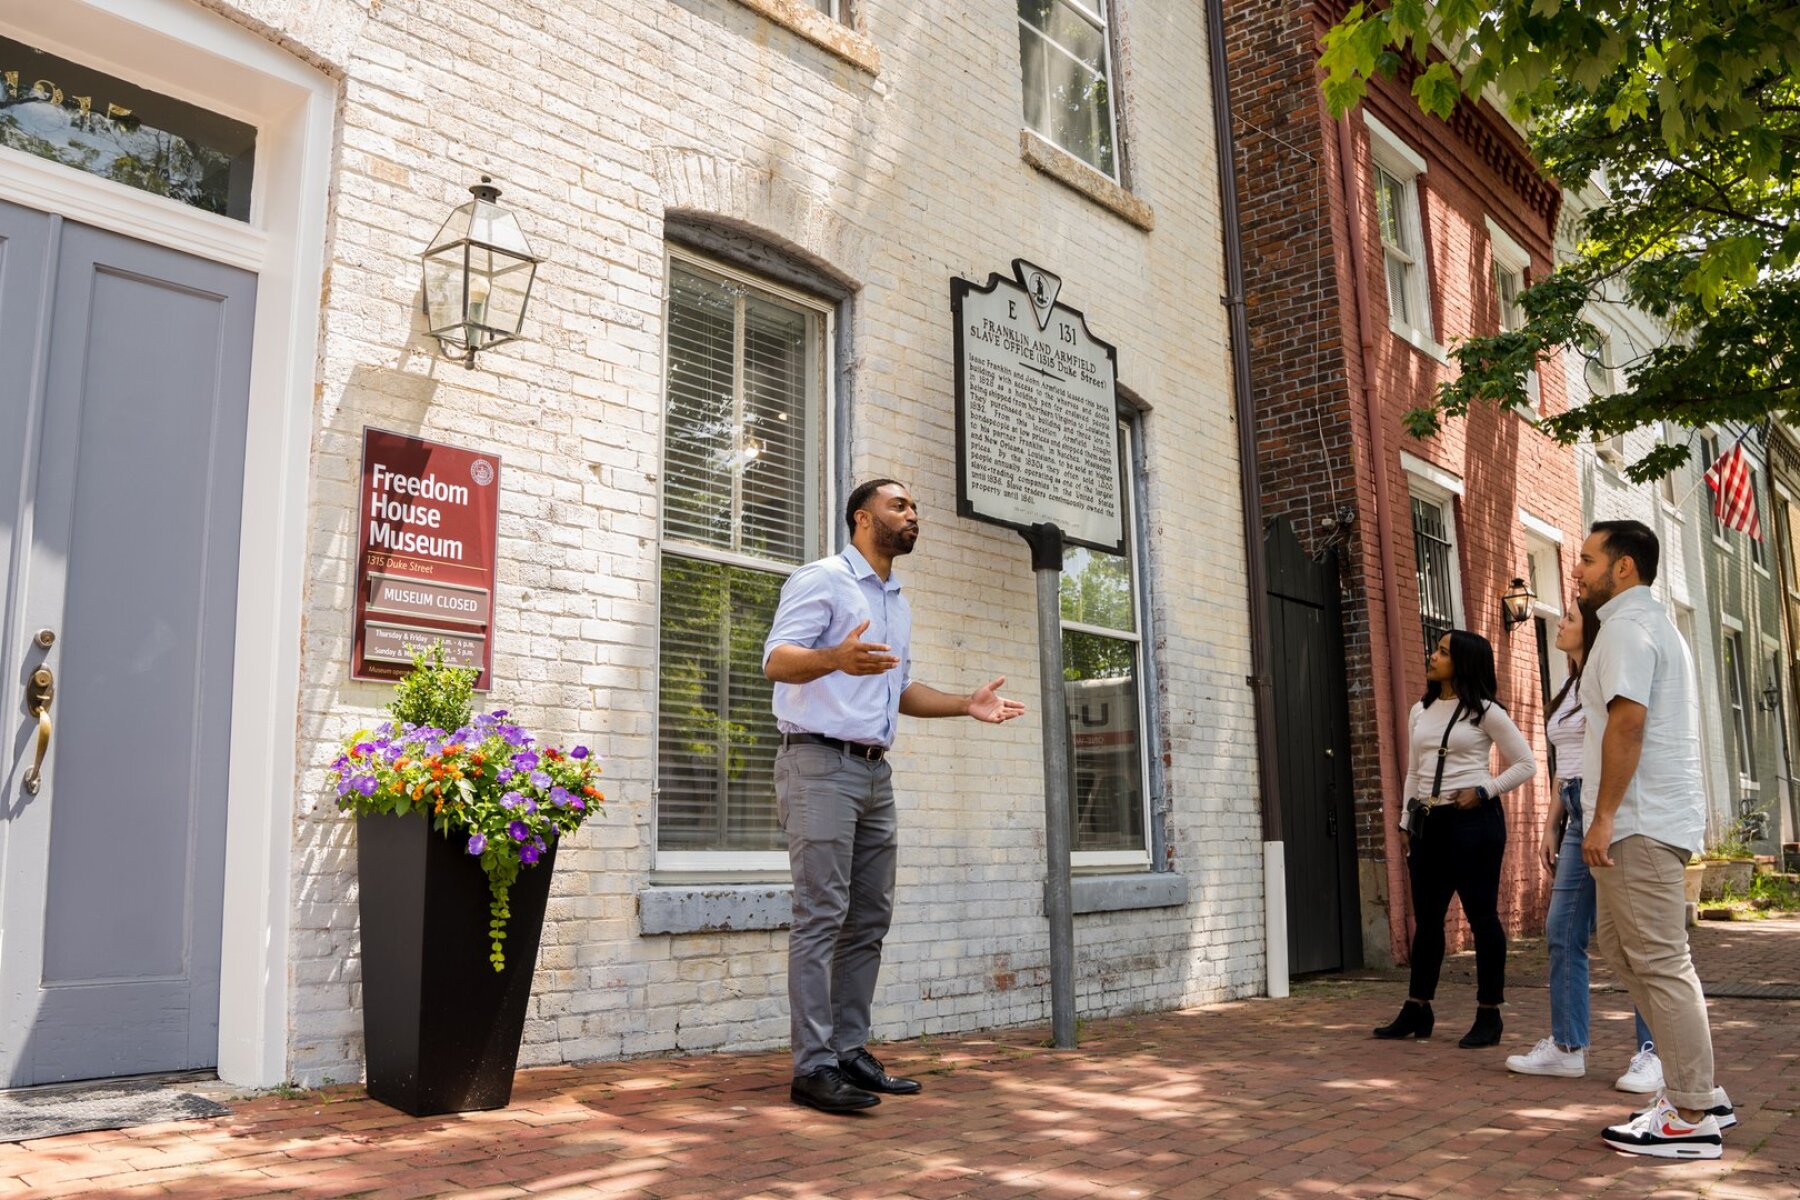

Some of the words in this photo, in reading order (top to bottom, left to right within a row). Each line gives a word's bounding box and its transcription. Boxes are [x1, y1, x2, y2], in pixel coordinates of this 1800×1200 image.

[1008, 300, 1017, 320] E
[1059, 322, 1077, 346] 131
[970, 324, 1000, 347] SLAVE
[1003, 338, 1034, 360] OFFICE
[1036, 352, 1054, 369] (1315
[1057, 360, 1077, 378] Duke
[1080, 370, 1106, 390] Street)
[983, 318, 1028, 347] FRANKLIN
[1033, 339, 1050, 356] AND
[1055, 348, 1095, 374] ARMFIELD
[969, 363, 995, 381] building
[998, 375, 1012, 385] with
[1014, 381, 1033, 393] access
[1036, 388, 1042, 396] to
[1044, 391, 1054, 400] the
[1093, 409, 1109, 421] docks
[969, 372, 975, 381] in
[1014, 389, 1039, 406] holding
[1040, 400, 1052, 409] pen
[1053, 403, 1062, 412] for
[1064, 409, 1090, 422] enslaved
[1092, 419, 1110, 430] people
[970, 382, 987, 397] being
[988, 390, 1011, 403] shipped
[1012, 397, 1026, 409] from
[1028, 403, 1053, 418] Northern
[1054, 412, 1076, 426] Virginia
[986, 360, 1011, 375] Franklin
[1013, 371, 1024, 380] and
[1025, 374, 1040, 386] John
[1041, 380, 1065, 396] Armfield
[1085, 397, 1094, 406] this
[1096, 401, 1108, 412] brick
[970, 392, 986, 406] They
[990, 401, 1022, 416] purchased
[1024, 411, 1035, 421] the
[1038, 416, 1061, 432] building
[1063, 426, 1074, 434] and
[1076, 429, 1091, 440] three
[970, 411, 1009, 431] bondspeople
[1019, 428, 1030, 437] low
[1032, 434, 1049, 444] prices
[1062, 443, 1083, 455] shipped
[1084, 449, 1098, 460] them
[1098, 456, 1111, 464] south
[970, 421, 977, 430] to
[980, 424, 989, 434] his
[992, 430, 1016, 442] partner
[1048, 446, 1054, 454] in
[994, 410, 1012, 422] From
[1016, 417, 1027, 427] this
[1032, 423, 1059, 438] location
[1062, 433, 1086, 447] Armfield
[970, 433, 982, 441] and
[984, 435, 997, 446] New
[1058, 459, 1065, 467] to
[1065, 461, 1073, 469] be
[1074, 466, 1086, 474] sold
[998, 449, 1008, 461] By
[1010, 453, 1021, 463] the
[1046, 464, 1060, 476] they
[1063, 470, 1079, 480] often
[372, 463, 468, 506] Freedom
[970, 453, 992, 464] people
[1024, 469, 1053, 484] operating
[1083, 485, 1093, 493] the
[1095, 488, 1113, 499] largest
[971, 462, 1014, 482] slave-trading
[1017, 476, 1049, 490] companies
[1062, 488, 1071, 496] the
[1075, 491, 1094, 503] United
[1098, 498, 1114, 508] States
[971, 482, 1000, 497] property
[1003, 491, 1018, 500] until
[971, 472, 986, 481] until
[1006, 480, 1022, 491] Slave
[1024, 485, 1046, 498] traders
[1086, 505, 1103, 514] owned
[1105, 508, 1114, 516] the
[370, 492, 441, 528] House
[369, 520, 462, 560] Museum
[367, 554, 384, 567] 1315
[387, 558, 408, 570] Duke
[410, 562, 433, 574] Street
[384, 588, 432, 606] MUSEUM
[437, 596, 477, 612] CLOSED
[375, 647, 396, 657] Sunday
[376, 629, 401, 640] Thursday
[410, 634, 428, 643] Friday
